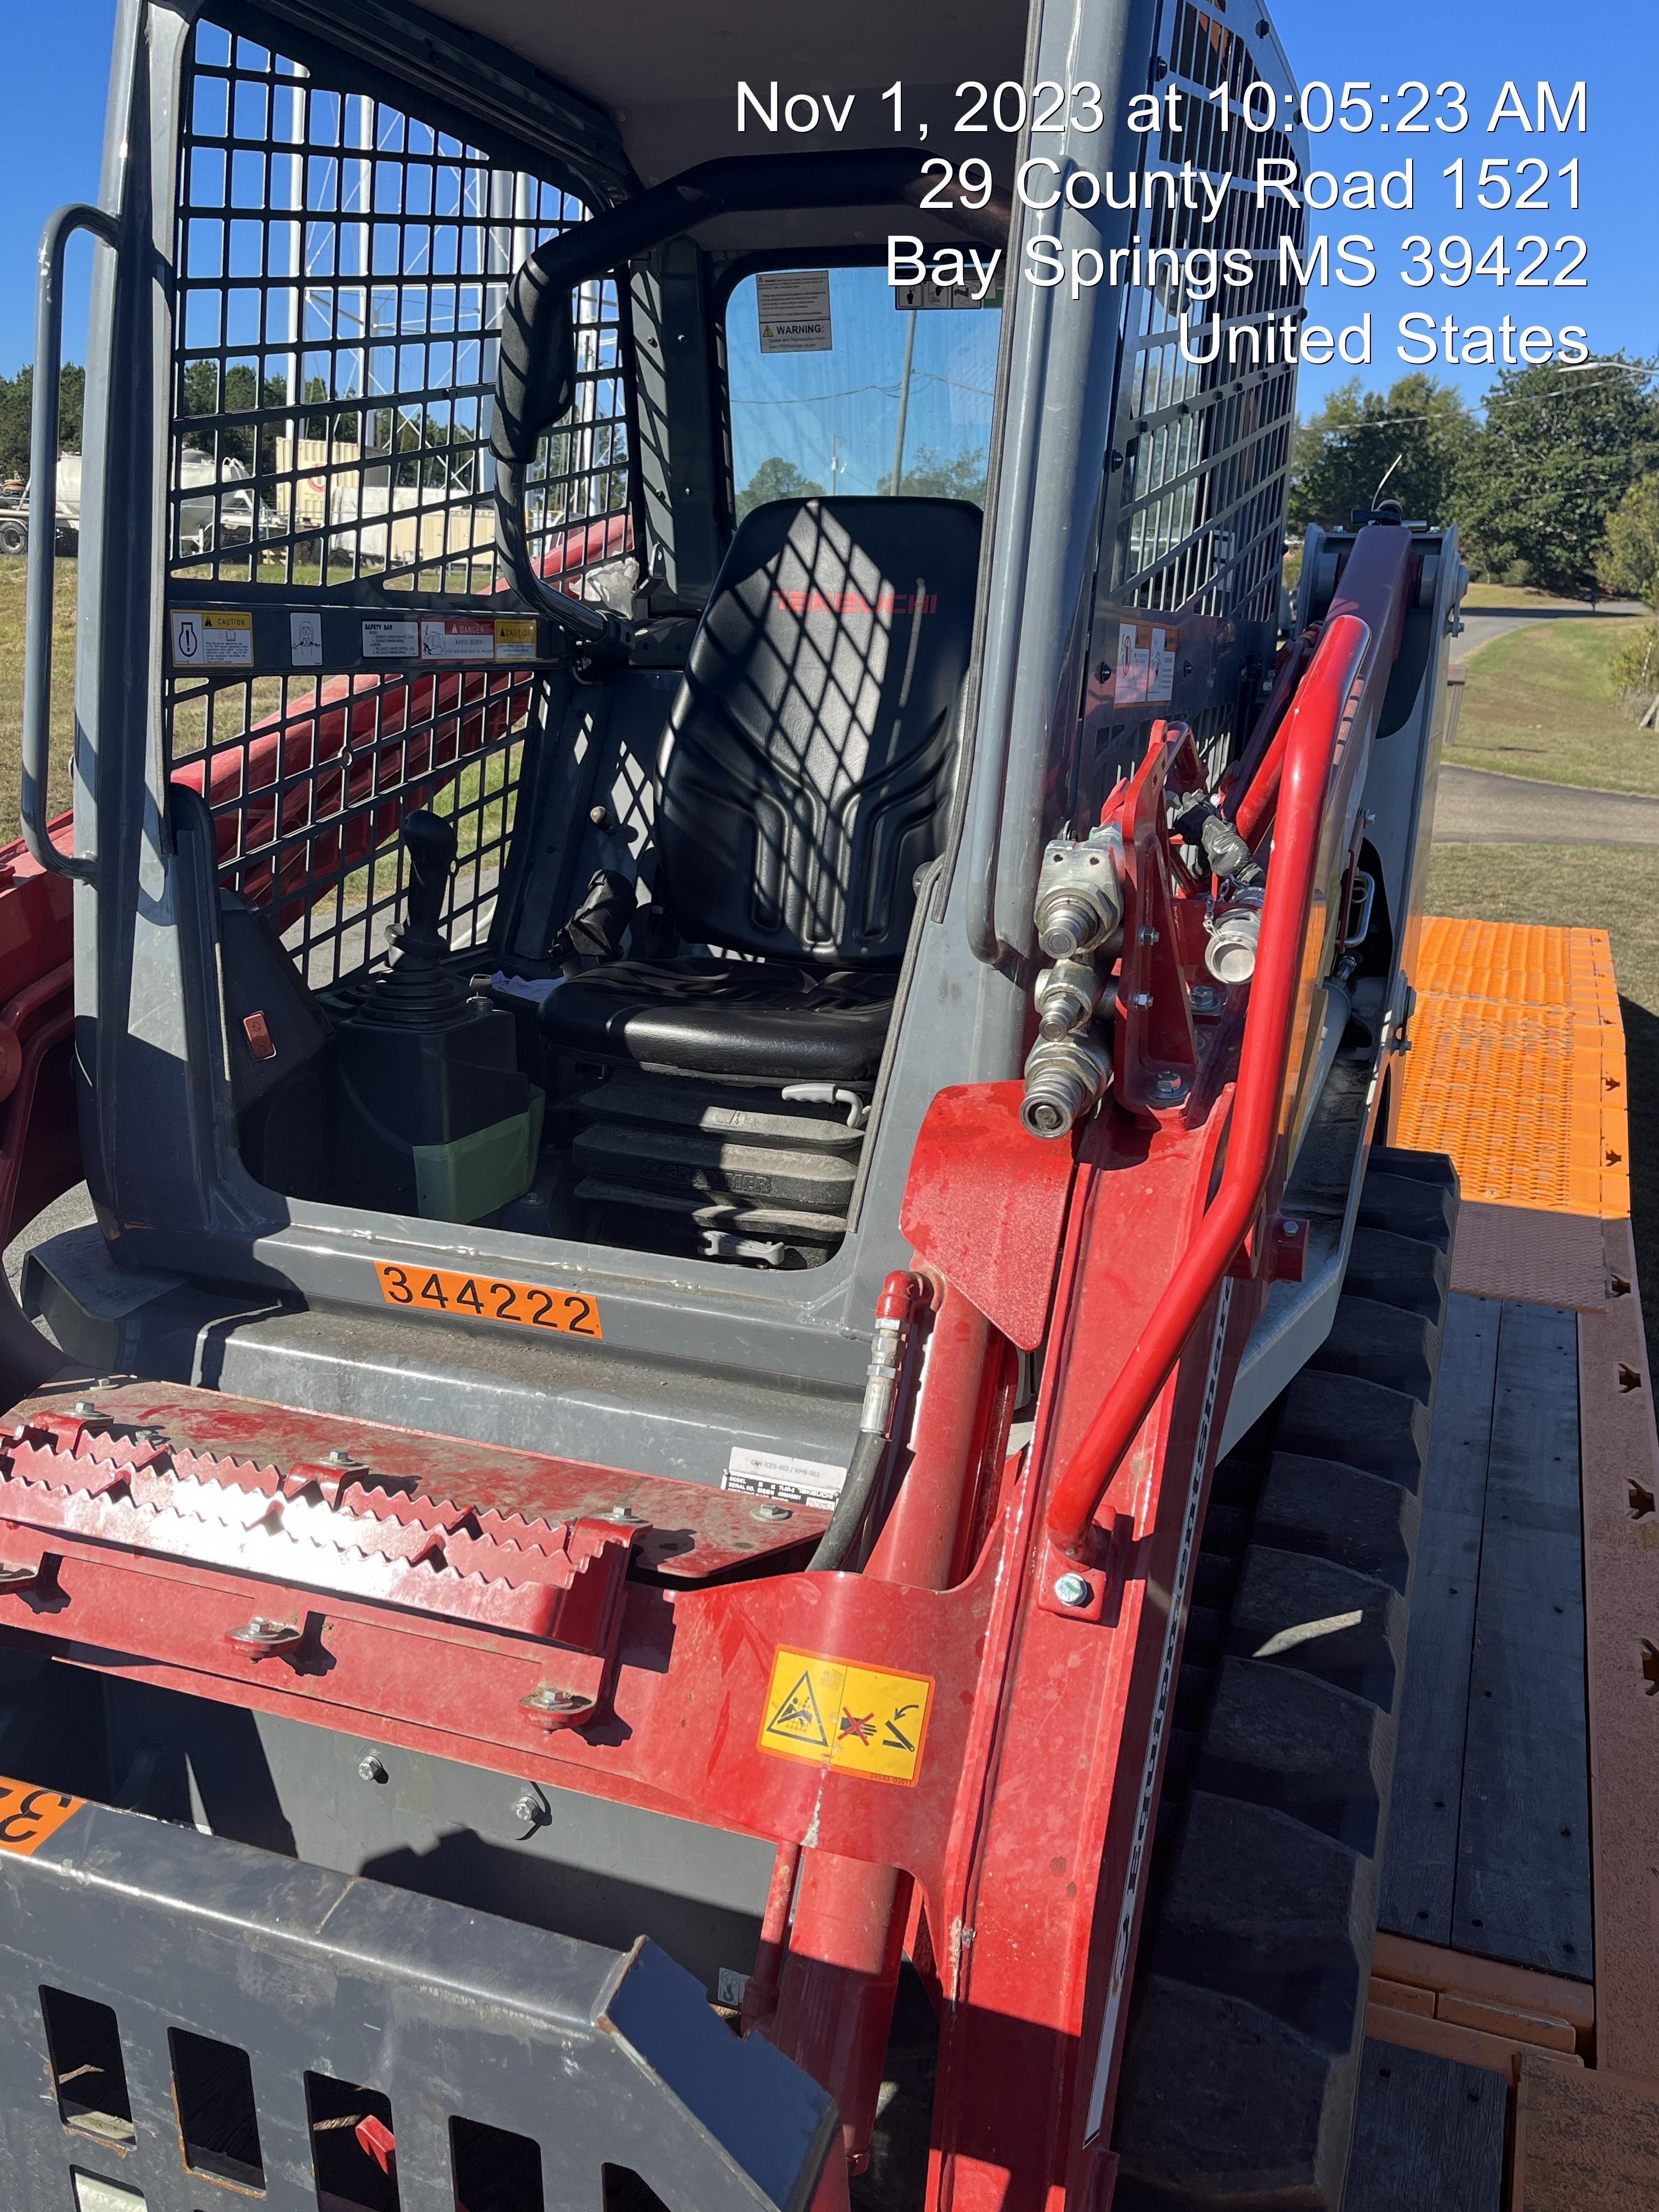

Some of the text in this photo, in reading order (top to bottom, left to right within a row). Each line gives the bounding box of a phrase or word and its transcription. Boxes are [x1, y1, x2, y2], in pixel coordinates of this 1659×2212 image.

[776, 324, 825, 335] WARNING:
[772, 590, 938, 614] TAKEUCHI
[460, 625, 484, 634] DANGER
[383, 1266, 595, 1335] 344222
[764, 1463, 789, 1471] ICES-002
[729, 1476, 746, 1485] MODEL
